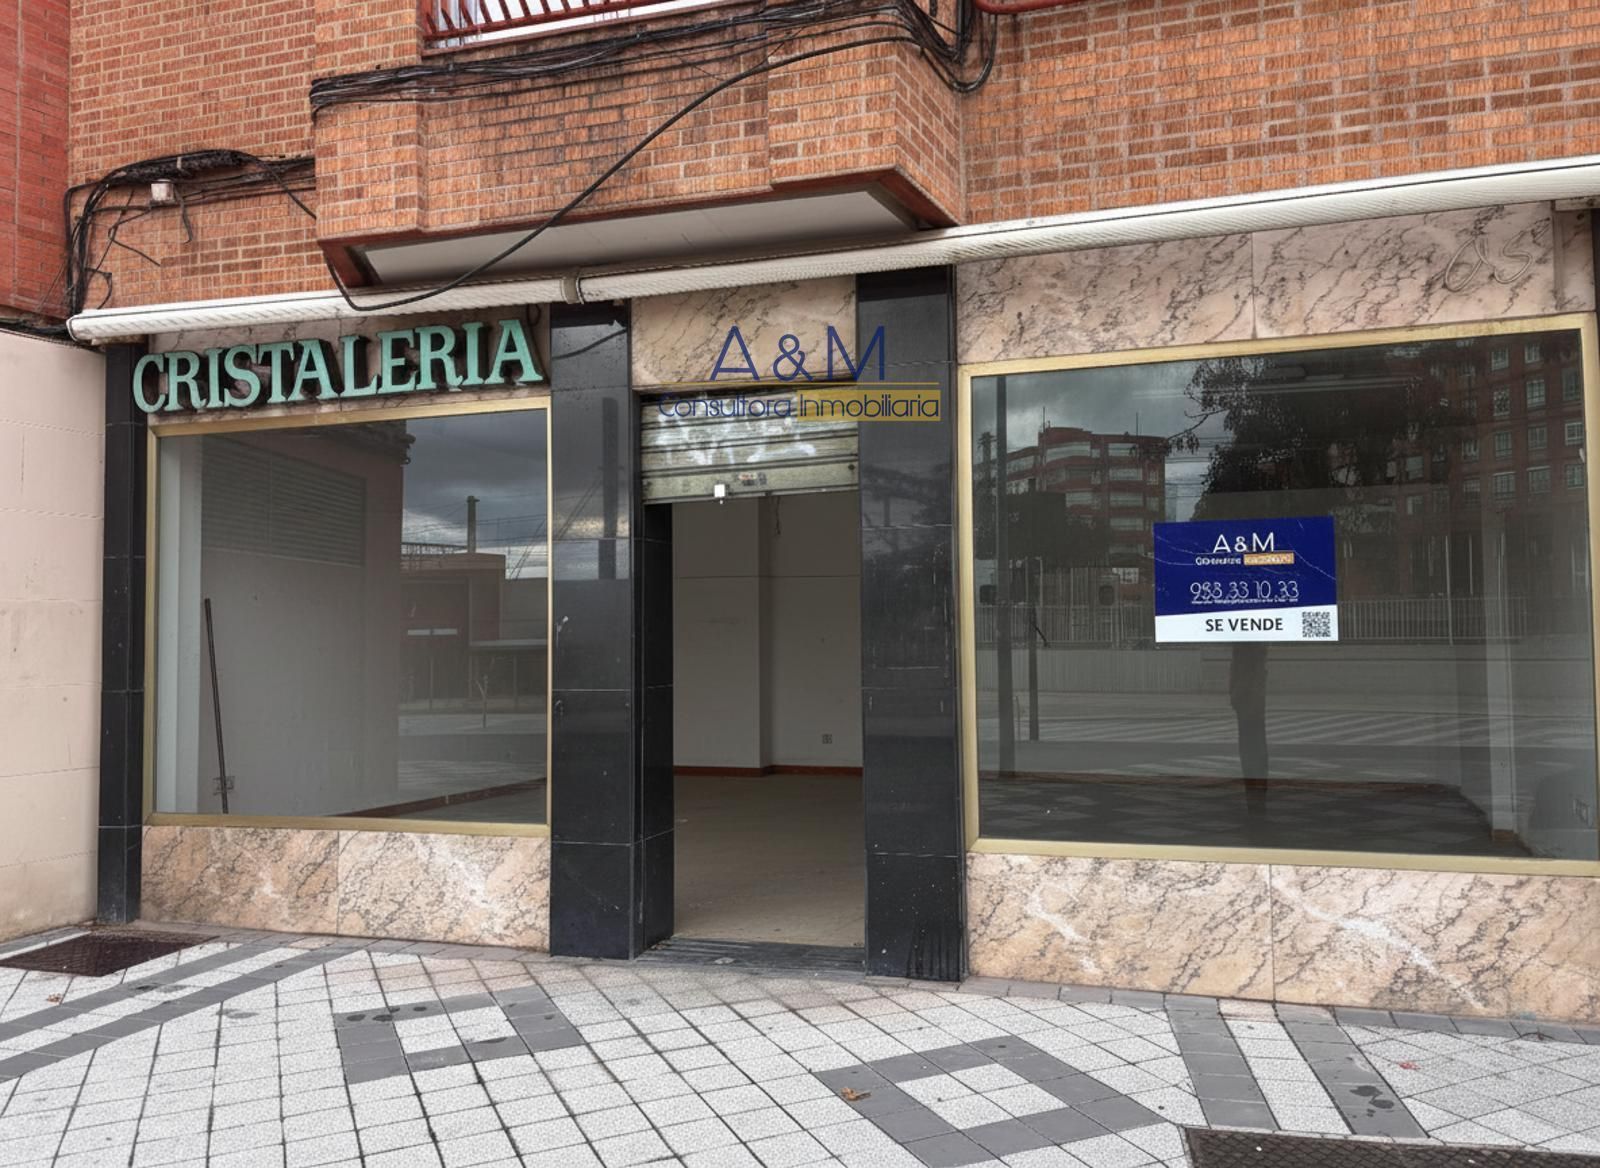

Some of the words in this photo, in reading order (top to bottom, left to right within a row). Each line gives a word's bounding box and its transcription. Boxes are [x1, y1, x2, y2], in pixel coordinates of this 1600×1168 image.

[132, 319, 543, 413] CRISTALERIA
[1213, 534, 1231, 553] A
[1234, 536, 1248, 552] &
[1252, 532, 1275, 553] M
[1205, 619, 1223, 632] SE
[1228, 618, 1283, 631] VENDE
